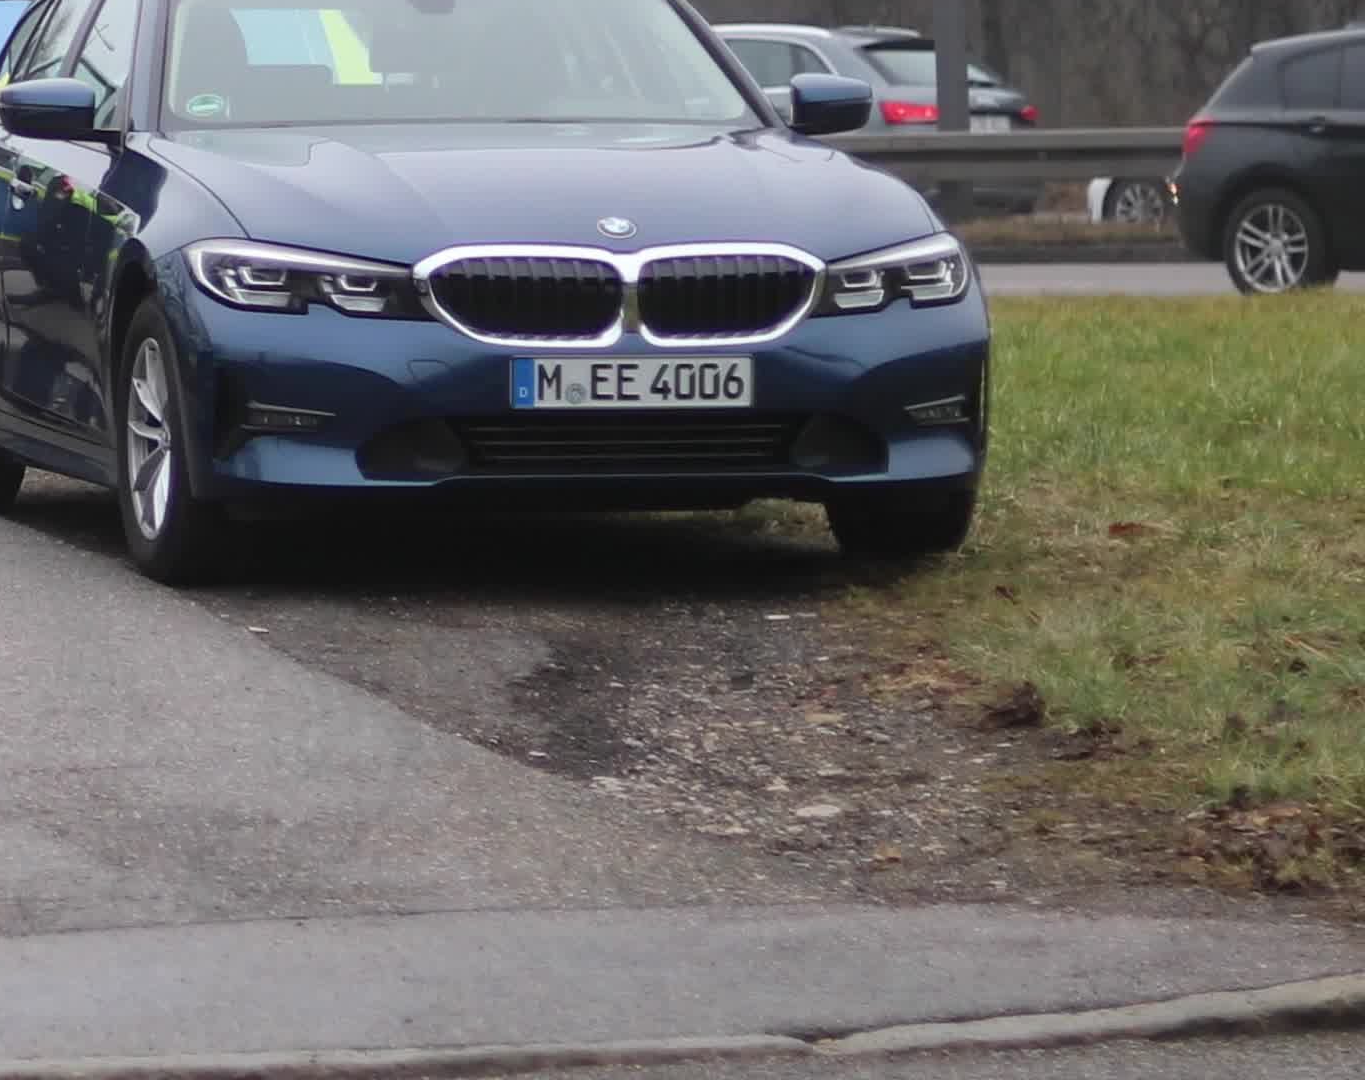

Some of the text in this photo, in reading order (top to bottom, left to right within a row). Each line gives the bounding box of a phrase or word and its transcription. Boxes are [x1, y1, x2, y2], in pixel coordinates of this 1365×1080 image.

[538, 364, 562, 401] M
[590, 363, 640, 401] EE
[650, 363, 744, 400] 4006
